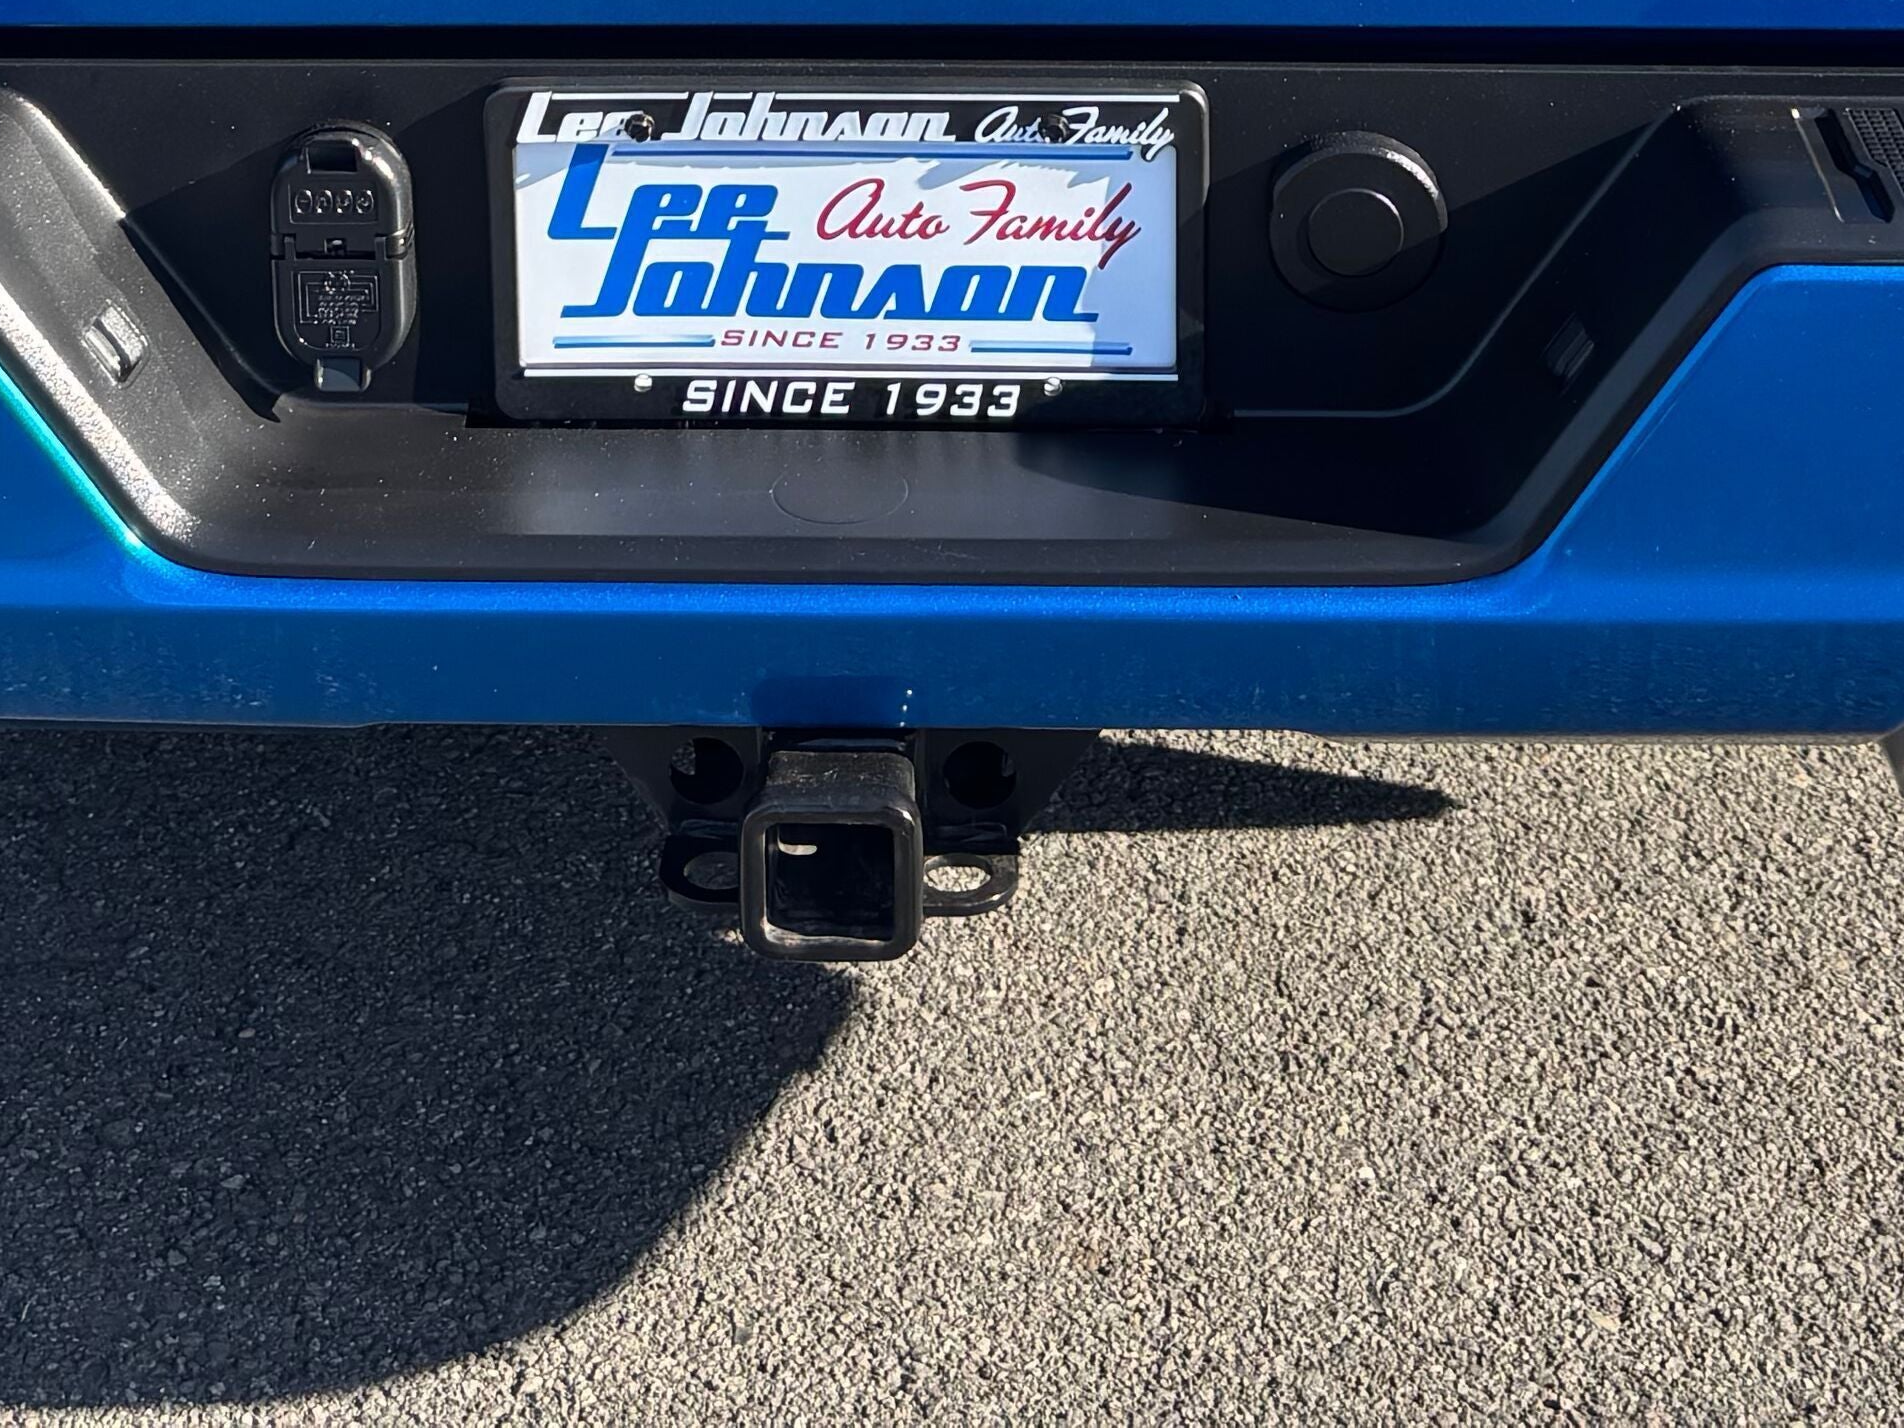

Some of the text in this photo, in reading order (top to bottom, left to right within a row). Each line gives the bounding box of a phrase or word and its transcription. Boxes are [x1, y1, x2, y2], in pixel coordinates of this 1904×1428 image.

[661, 90, 956, 142] Johnson
[974, 105, 1053, 143] Aut
[1061, 105, 1175, 161] Family
[547, 143, 791, 240] Lee
[815, 178, 1142, 270] Auto Family
[560, 222, 1099, 322] Johnson
[720, 329, 962, 353] SINCE 1933
[682, 378, 1021, 418] SINCE 1933
